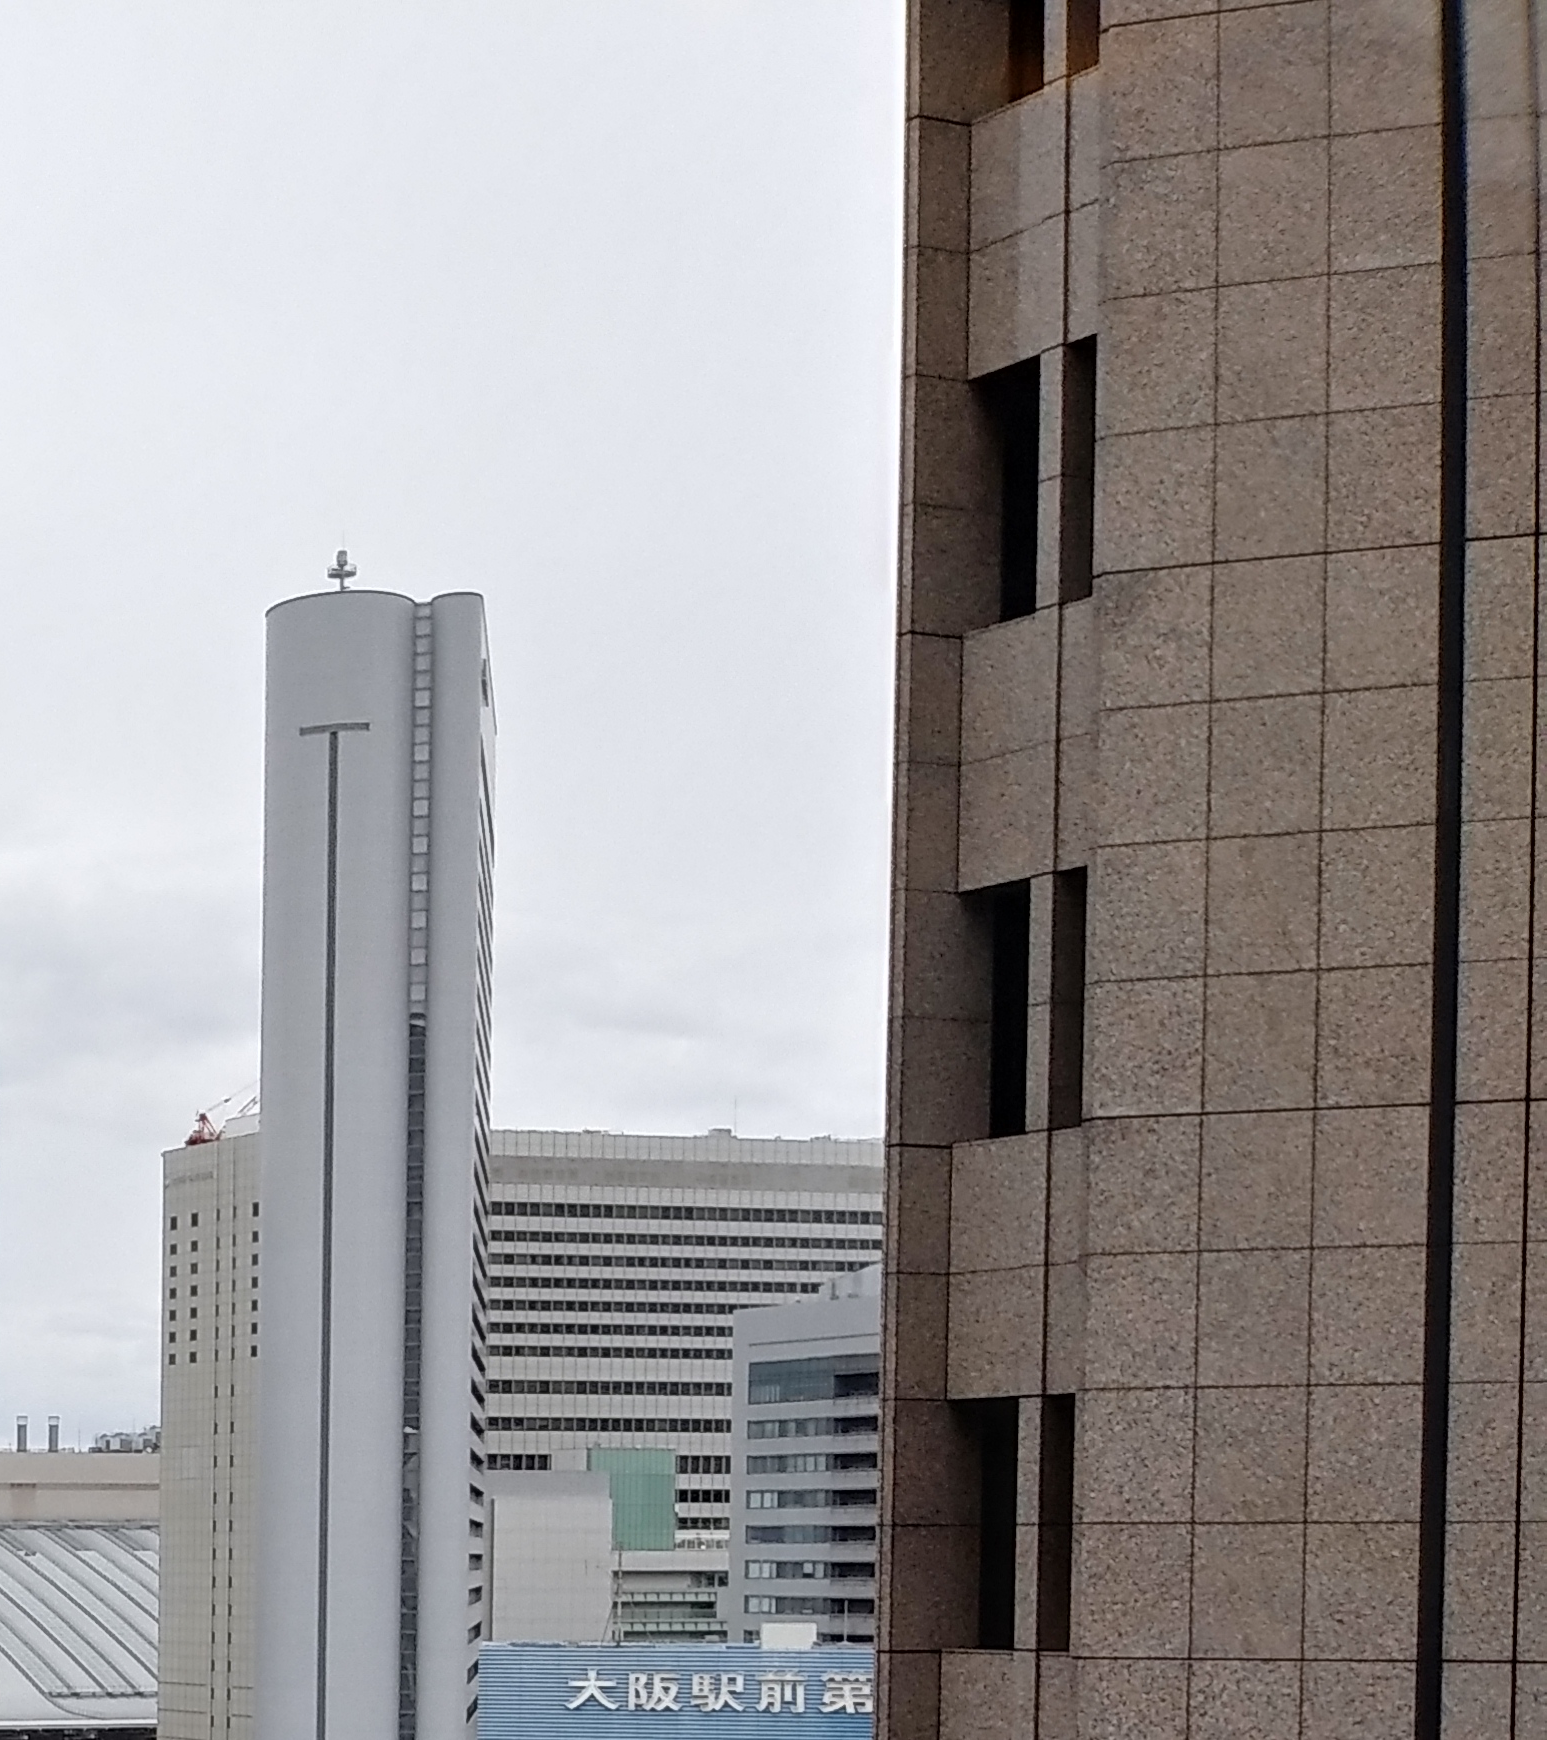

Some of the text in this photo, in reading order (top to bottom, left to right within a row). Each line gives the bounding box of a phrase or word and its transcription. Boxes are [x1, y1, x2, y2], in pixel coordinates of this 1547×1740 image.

[563, 1667, 875, 1714] 大阪駅前第
